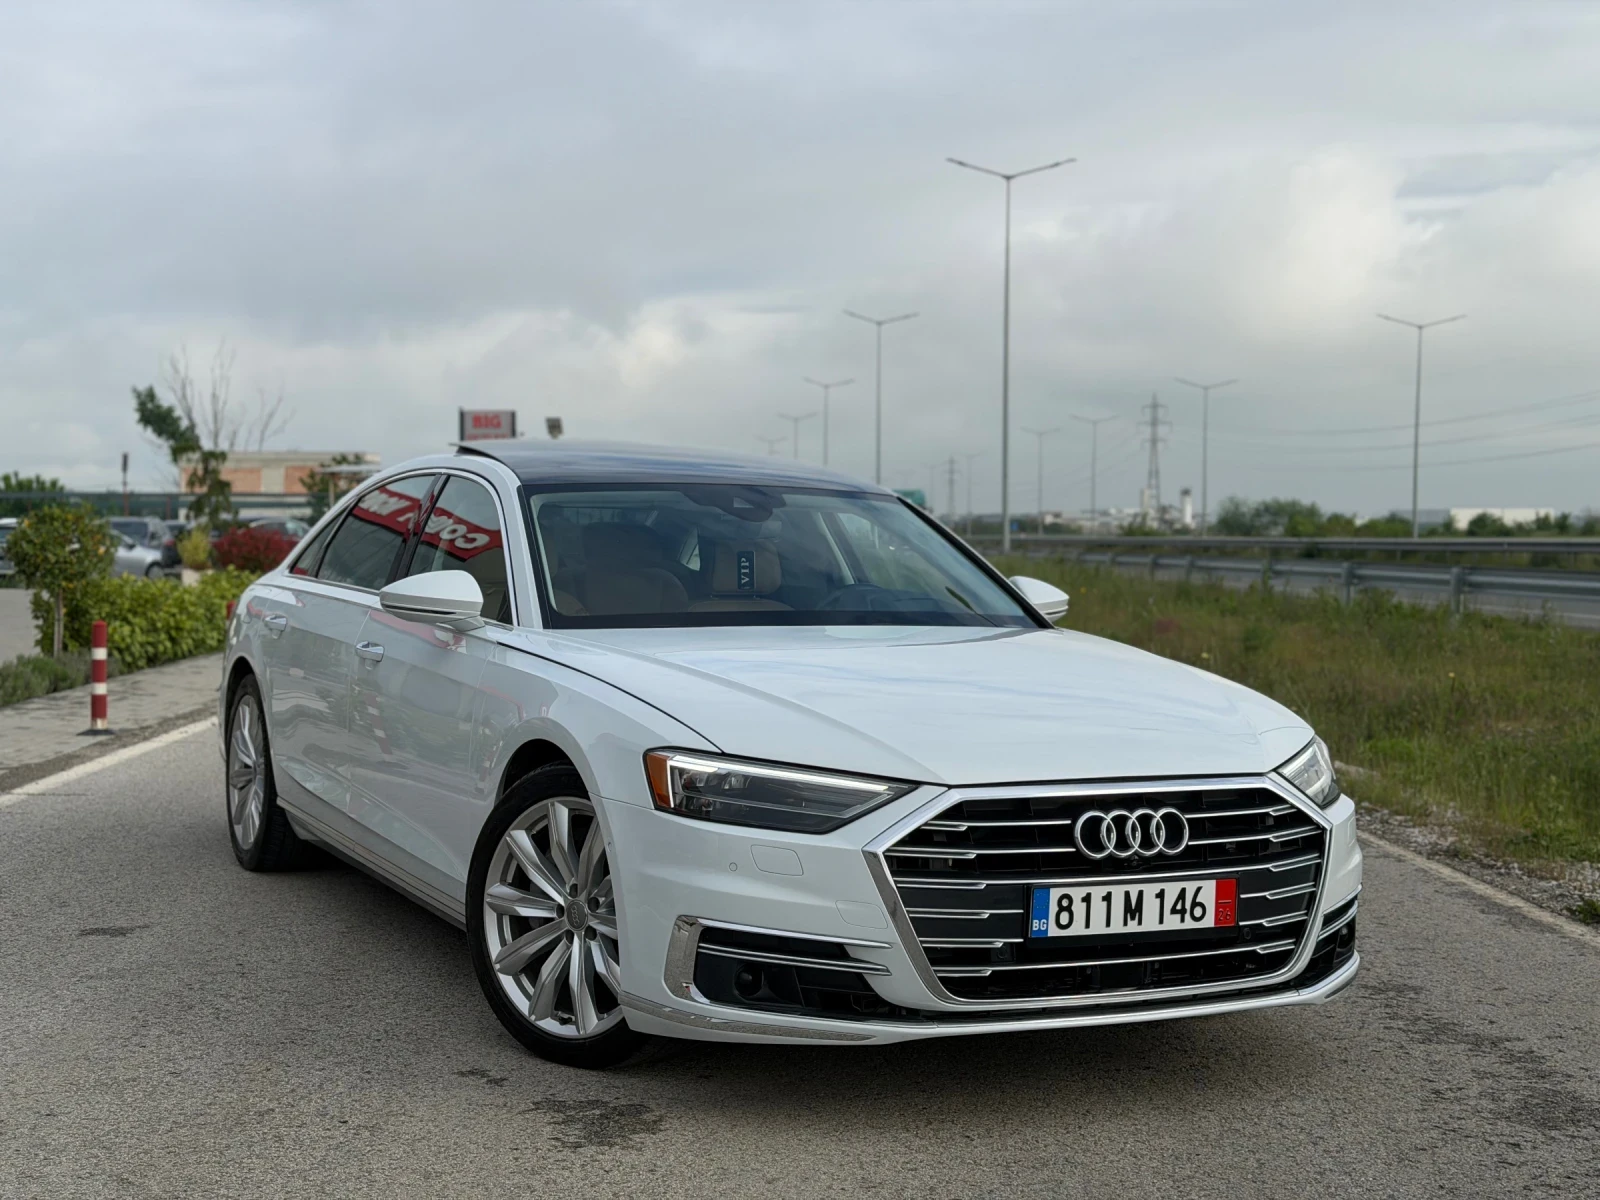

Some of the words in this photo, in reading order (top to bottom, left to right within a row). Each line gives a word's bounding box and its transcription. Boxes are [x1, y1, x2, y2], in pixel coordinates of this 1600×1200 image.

[472, 414, 502, 429] BIG
[740, 557, 750, 585] VIP
[1032, 919, 1047, 931] BG
